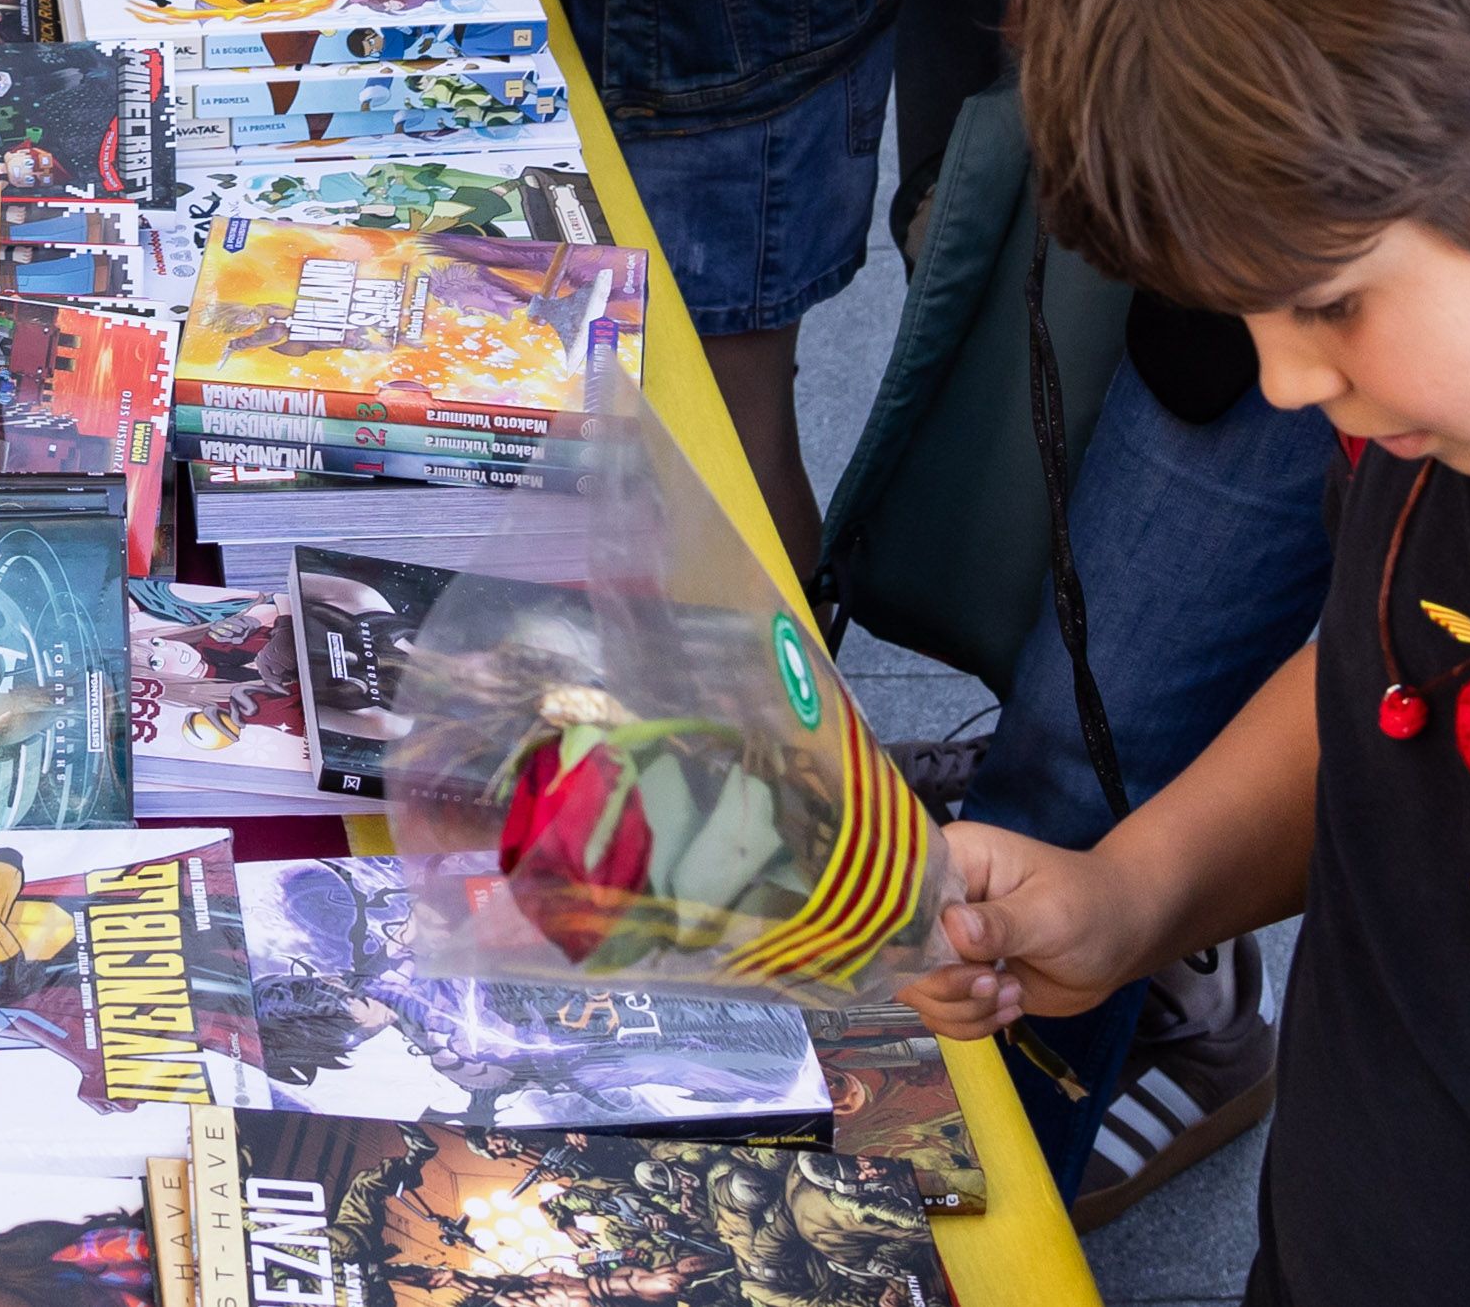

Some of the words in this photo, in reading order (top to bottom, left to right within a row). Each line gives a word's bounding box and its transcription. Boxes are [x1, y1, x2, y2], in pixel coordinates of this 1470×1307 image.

[222, 46, 264, 55] BÚSQUEDA
[213, 97, 250, 105] PROMESA
[118, 48, 154, 201] MINECRAFT
[249, 123, 286, 132] PROMESA
[287, 258, 356, 342] VINLAND
[117, 389, 133, 416] SETO
[356, 402, 387, 421] 3
[425, 409, 490, 430] Yukimura
[491, 416, 547, 435] Makoto
[130, 422, 146, 463] NORMA
[354, 426, 388, 446] 2
[424, 435, 490, 455] Yukimura
[491, 442, 546, 459] Makoto
[355, 461, 386, 473] 1
[423, 464, 487, 483] Yukimura
[54, 642, 65, 707] KUROI
[90, 672, 100, 709] MANGA
[91, 710, 101, 750] DISTRITO
[56, 720, 67, 782] SHIRO
[188, 857, 205, 881] UNO
[191, 881, 212, 931] VOLUMEN
[85, 859, 211, 1105] INVENCIBLE
